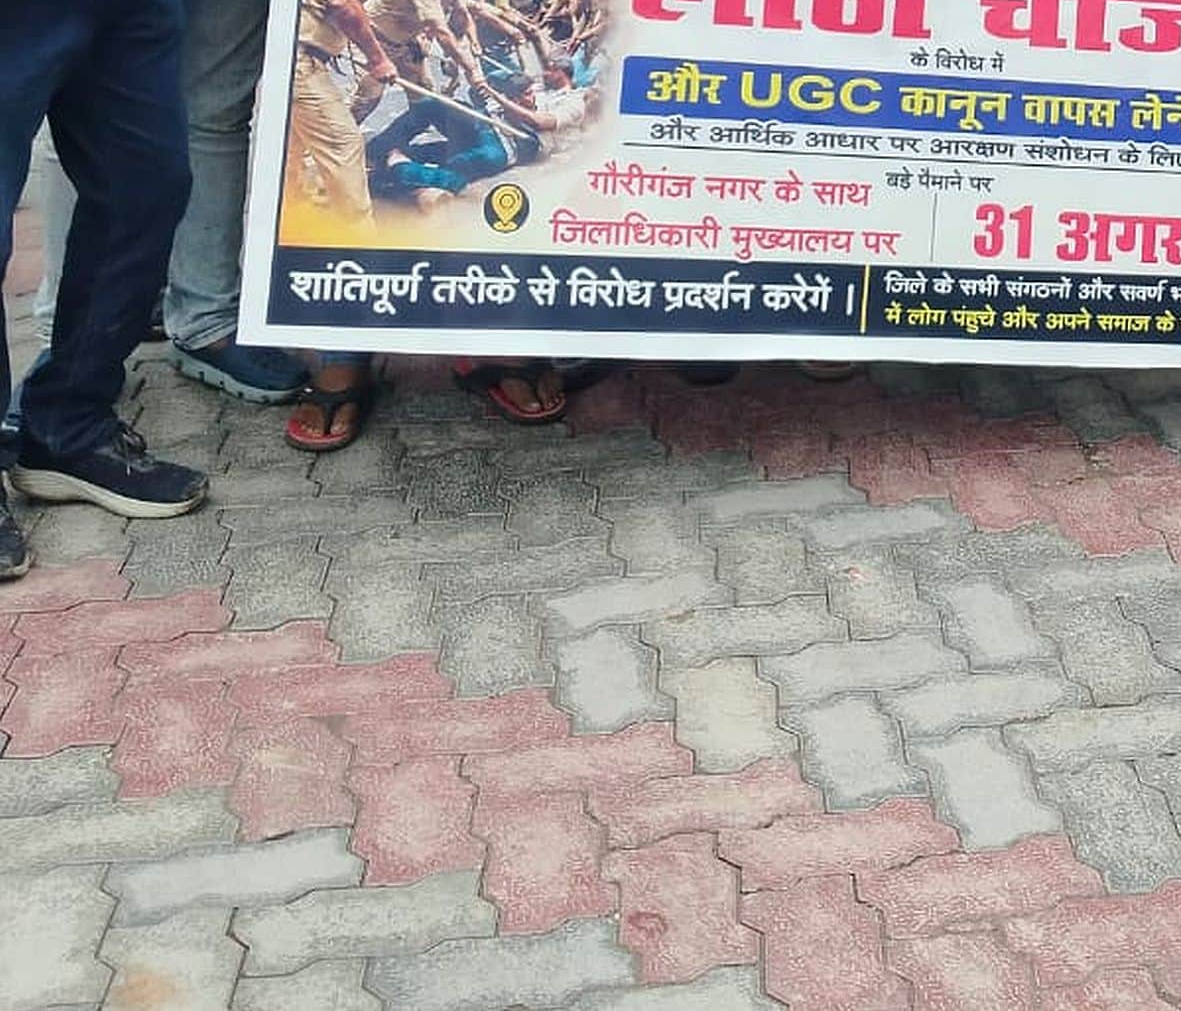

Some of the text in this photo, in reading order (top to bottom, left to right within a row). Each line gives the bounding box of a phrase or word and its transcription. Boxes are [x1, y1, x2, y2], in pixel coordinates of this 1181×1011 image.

[910, 47, 1005, 73] के विरोध में
[646, 63, 728, 105] और
[740, 71, 882, 114] UGC
[899, 87, 1012, 130] कानून
[1022, 95, 1120, 128] वापस
[650, 117, 700, 141] और
[710, 120, 797, 146] आर्थिक
[805, 133, 883, 151] आधार
[890, 137, 922, 153] पर
[930, 138, 1014, 157] आरक्षण
[1024, 138, 1112, 163] संशोधन
[1117, 143, 1139, 164] के
[588, 161, 872, 207] गौरीगंज नगर के साथ
[918, 167, 964, 191] पैमाने
[968, 177, 995, 193] पर
[549, 208, 901, 260] जिलाधिकारी मुख्यालय पर
[974, 203, 1033, 260] 31
[290, 260, 429, 314] शांतिपूर्ण
[431, 266, 518, 305] तरीके
[529, 269, 559, 306] से
[568, 268, 653, 308] विरोध
[663, 270, 754, 310] प्रदर्शन
[884, 270, 926, 294] जिले
[933, 271, 952, 295] के
[959, 273, 999, 297] सभी
[1005, 276, 1072, 300] संगठनों
[1078, 277, 1115, 300] और
[1120, 279, 1168, 303] सवर्ण
[885, 302, 901, 325] में
[907, 302, 947, 326] लोग
[1002, 306, 1039, 330] और
[1046, 308, 1092, 332] अपने
[1096, 313, 1151, 333] समाज
[1156, 310, 1175, 333] के
